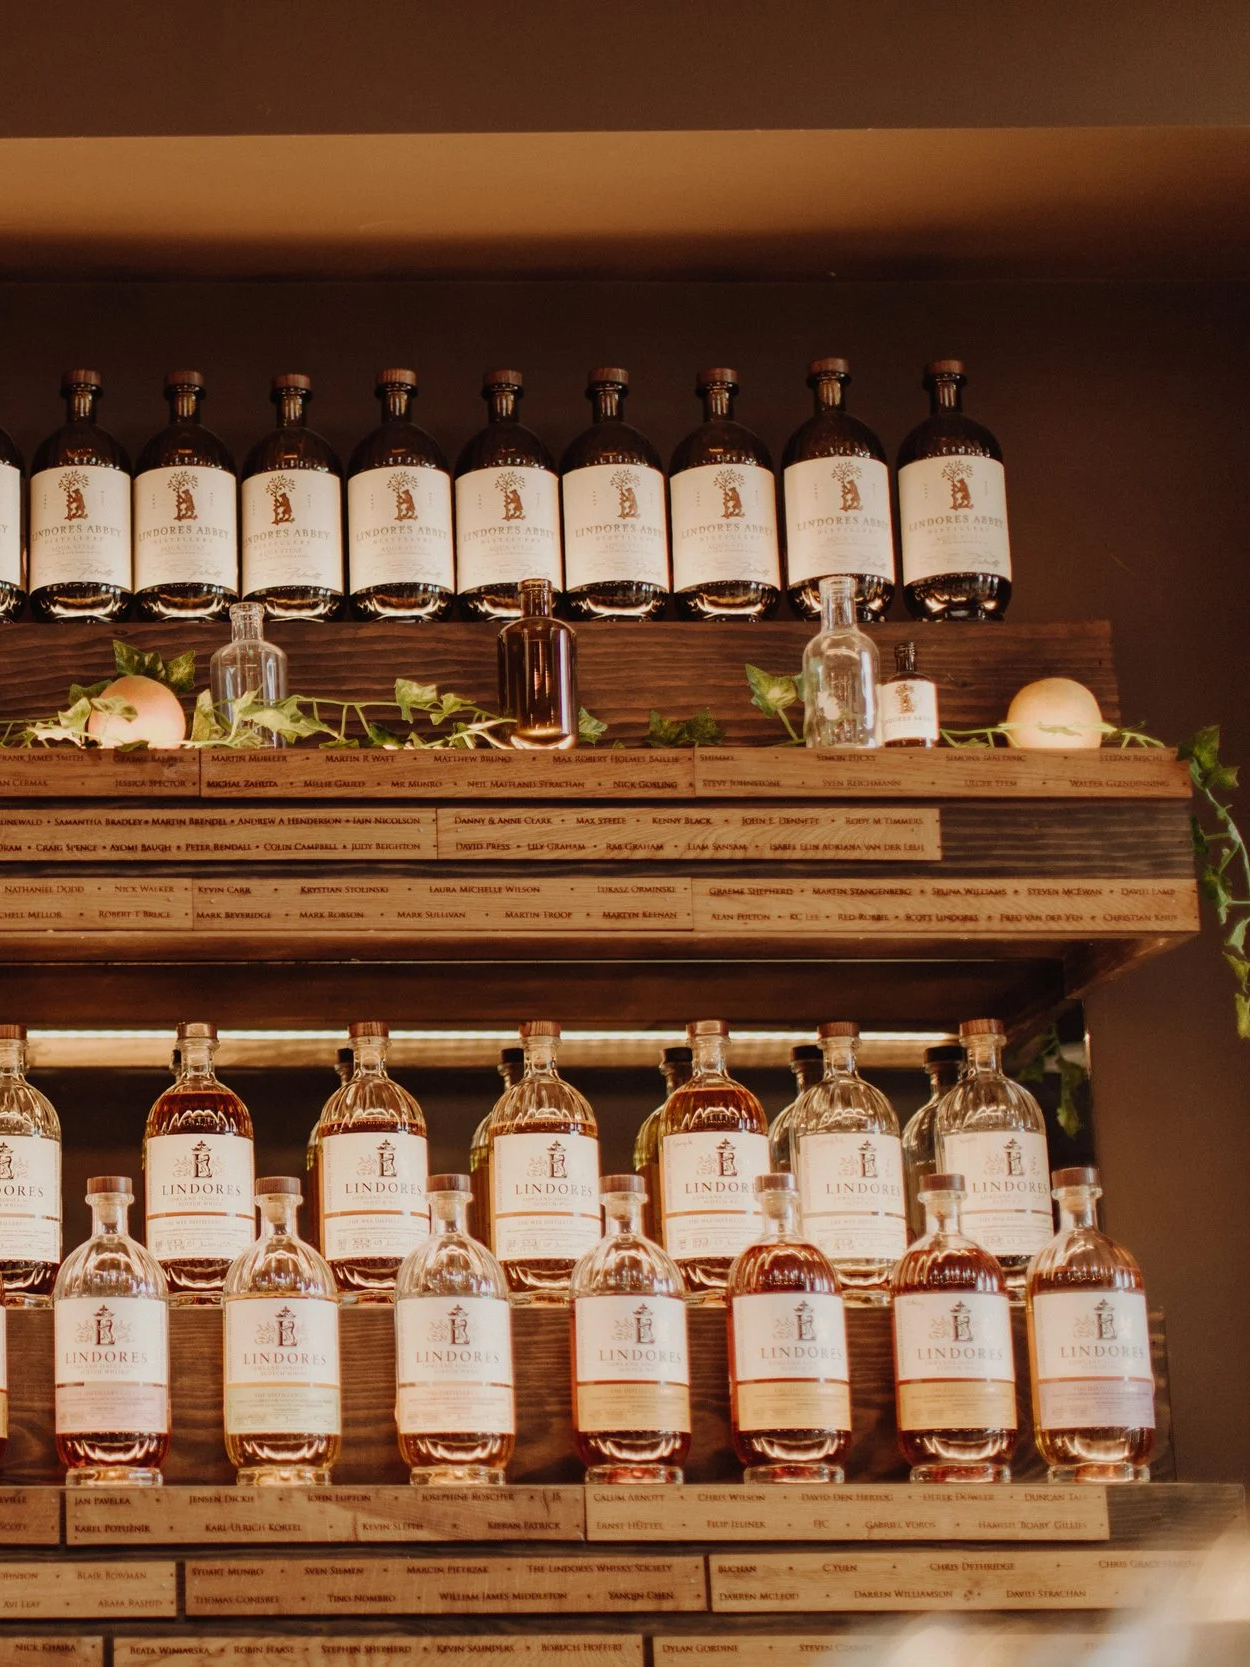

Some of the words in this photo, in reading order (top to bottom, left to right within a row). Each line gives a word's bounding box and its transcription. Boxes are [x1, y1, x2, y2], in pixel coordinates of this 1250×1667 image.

[797, 516, 853, 531] LINDORES
[909, 514, 969, 531] LINDORES
[86, 525, 121, 538] ABBEY
[193, 525, 229, 538] ABBEY
[294, 526, 330, 541] ABBEY
[356, 525, 412, 542] LINDORES
[416, 526, 447, 540] ABBEY
[463, 526, 521, 543] LINDORES
[575, 523, 631, 539] LINDORES
[682, 522, 740, 539] LINDORES
[162, 1184, 245, 1197] LINDORES
[345, 1182, 423, 1196] LINDORES
[515, 1182, 593, 1197] LINDORES
[685, 1180, 756, 1194] LINDORE
[826, 1181, 903, 1197] LINDORES
[973, 1181, 1048, 1196] LINDORES
[65, 1351, 148, 1365] LINDORES
[243, 1351, 327, 1366] LINDORES
[416, 1350, 500, 1365] LINDORES
[599, 1347, 681, 1364] LINDORES
[760, 1346, 843, 1361] LINDORES
[917, 1346, 1003, 1361] LINDORES
[1060, 1345, 1145, 1360] LINDORES
